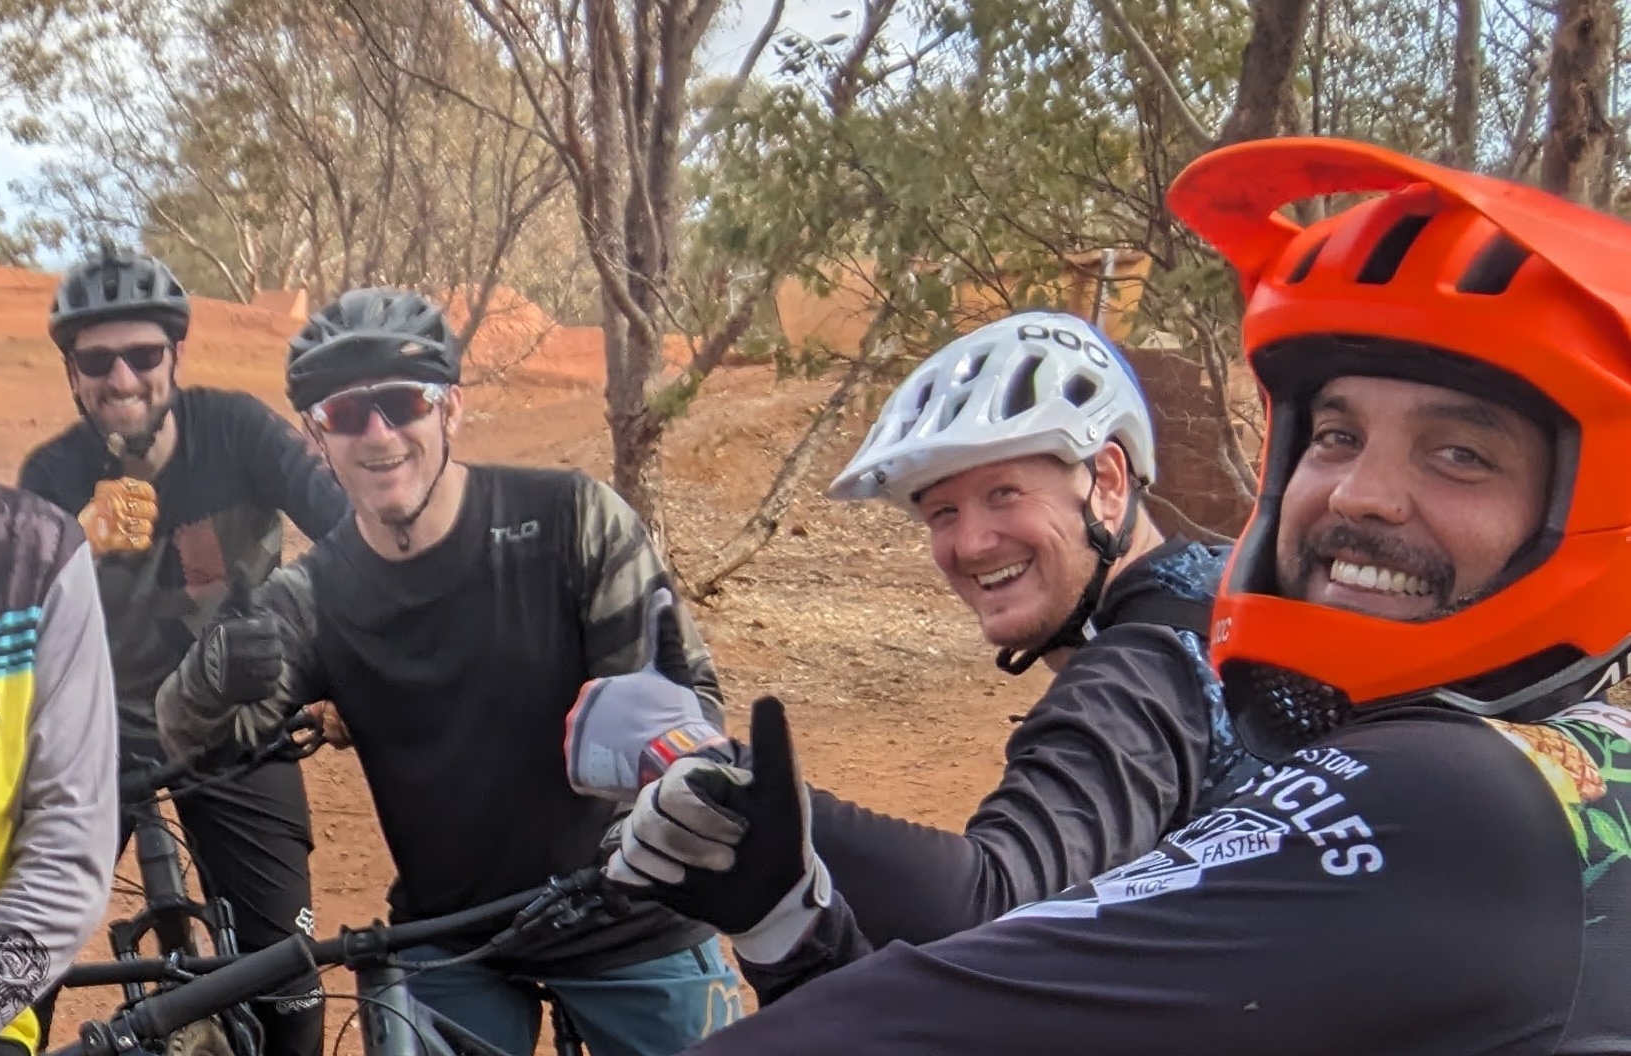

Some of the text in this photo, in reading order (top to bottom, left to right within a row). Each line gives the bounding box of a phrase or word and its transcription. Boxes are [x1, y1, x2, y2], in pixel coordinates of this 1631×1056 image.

[1016, 324, 1109, 369] POC
[1293, 746, 1369, 782] STOM
[1202, 829, 1270, 865] FASTER
